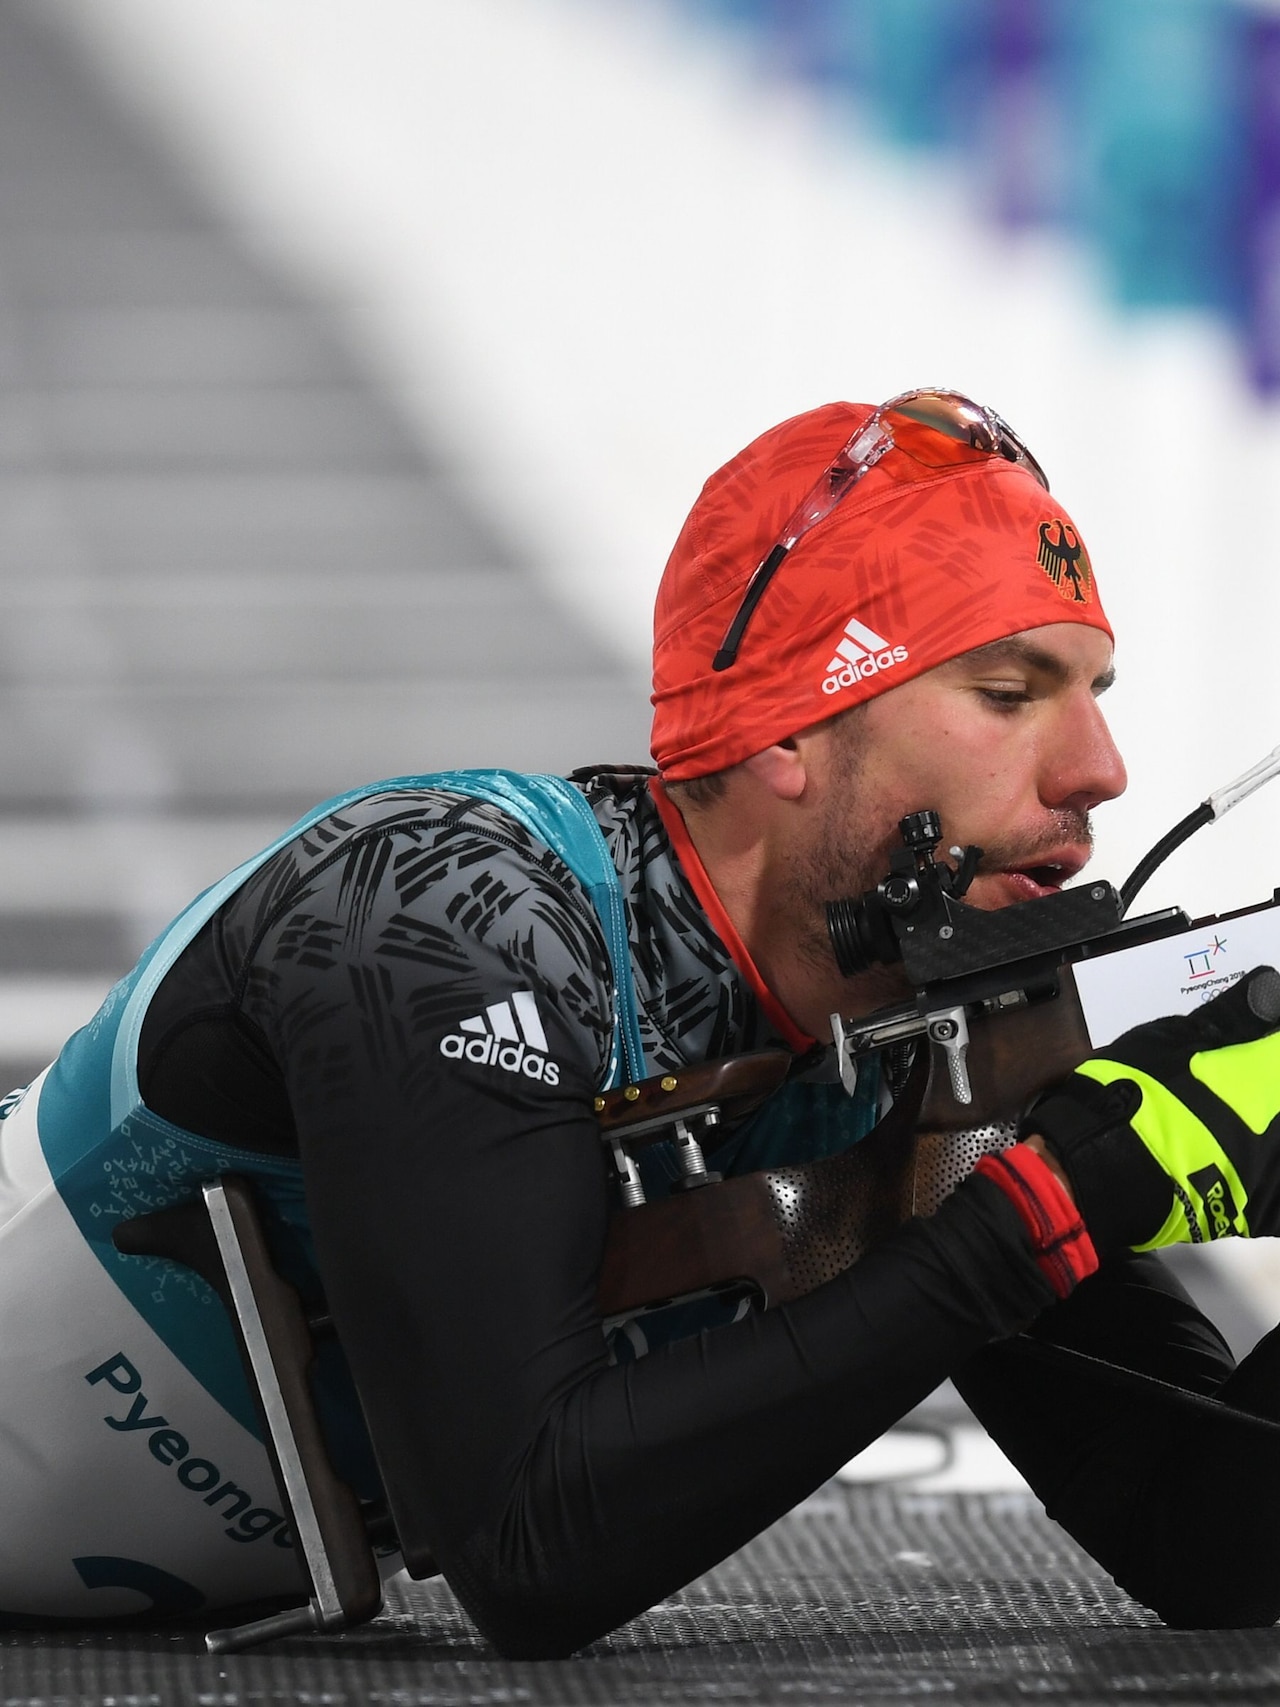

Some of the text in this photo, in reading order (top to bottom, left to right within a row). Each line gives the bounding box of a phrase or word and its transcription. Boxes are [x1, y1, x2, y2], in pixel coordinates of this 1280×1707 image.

[821, 644, 909, 695] adidas
[1180, 975, 1230, 995] PyeongChang
[439, 1034, 561, 1086] adidas
